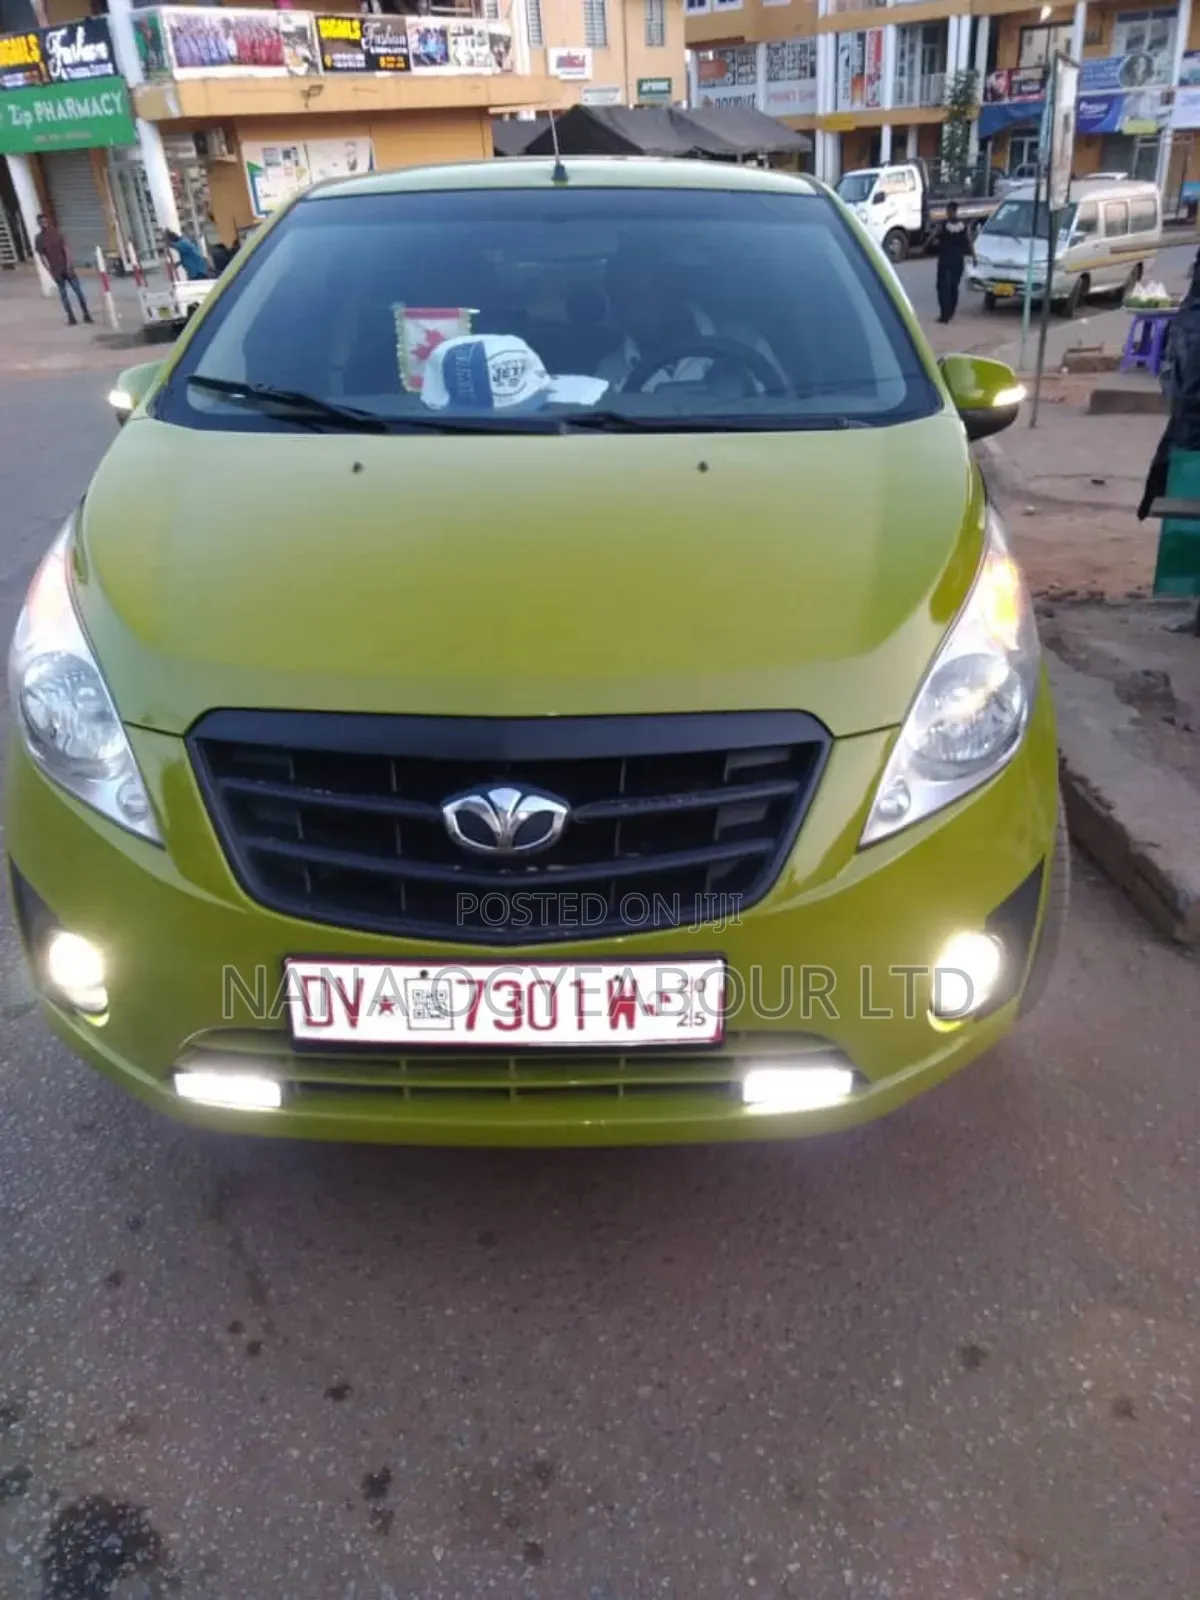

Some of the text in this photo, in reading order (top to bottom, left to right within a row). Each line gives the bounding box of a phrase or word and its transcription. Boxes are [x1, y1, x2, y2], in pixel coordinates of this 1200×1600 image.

[34, 91, 123, 123] PHARMACY
[301, 974, 638, 1033] DV 7301 W
[676, 1011, 708, 1028] 25
